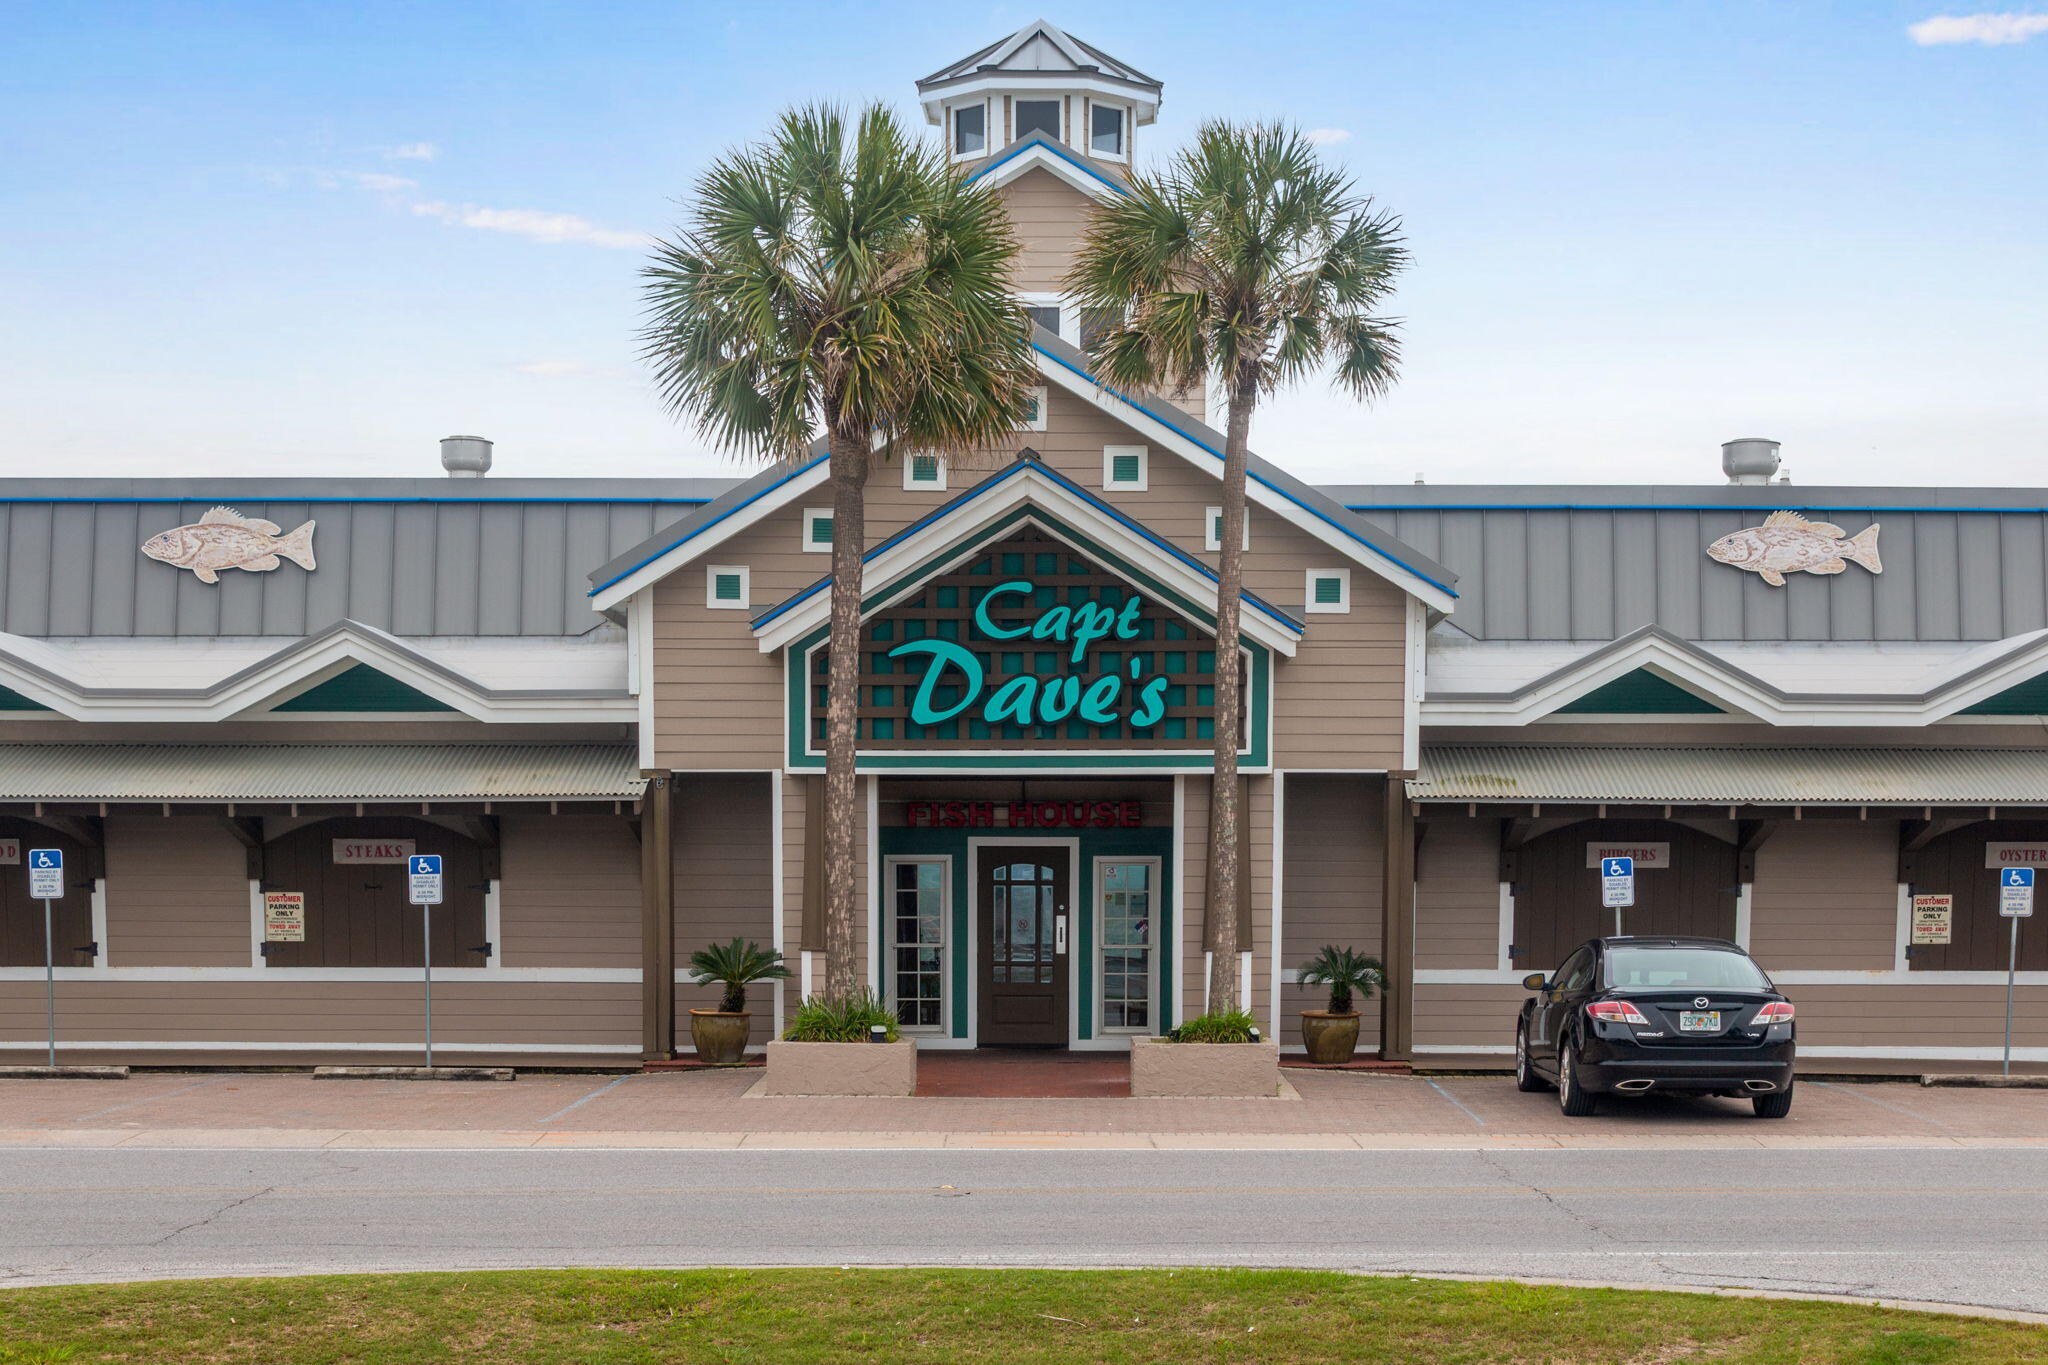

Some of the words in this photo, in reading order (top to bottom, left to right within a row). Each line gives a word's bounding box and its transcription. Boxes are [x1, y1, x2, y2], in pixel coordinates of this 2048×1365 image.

[975, 581, 1141, 663] Capt
[888, 639, 1168, 727] Dave's
[907, 801, 994, 828] FISH
[1008, 801, 1142, 828] HOUSE
[345, 844, 404, 858] STEAKS
[1599, 848, 1657, 861] BURGERS
[2000, 849, 2047, 861] OYSTER
